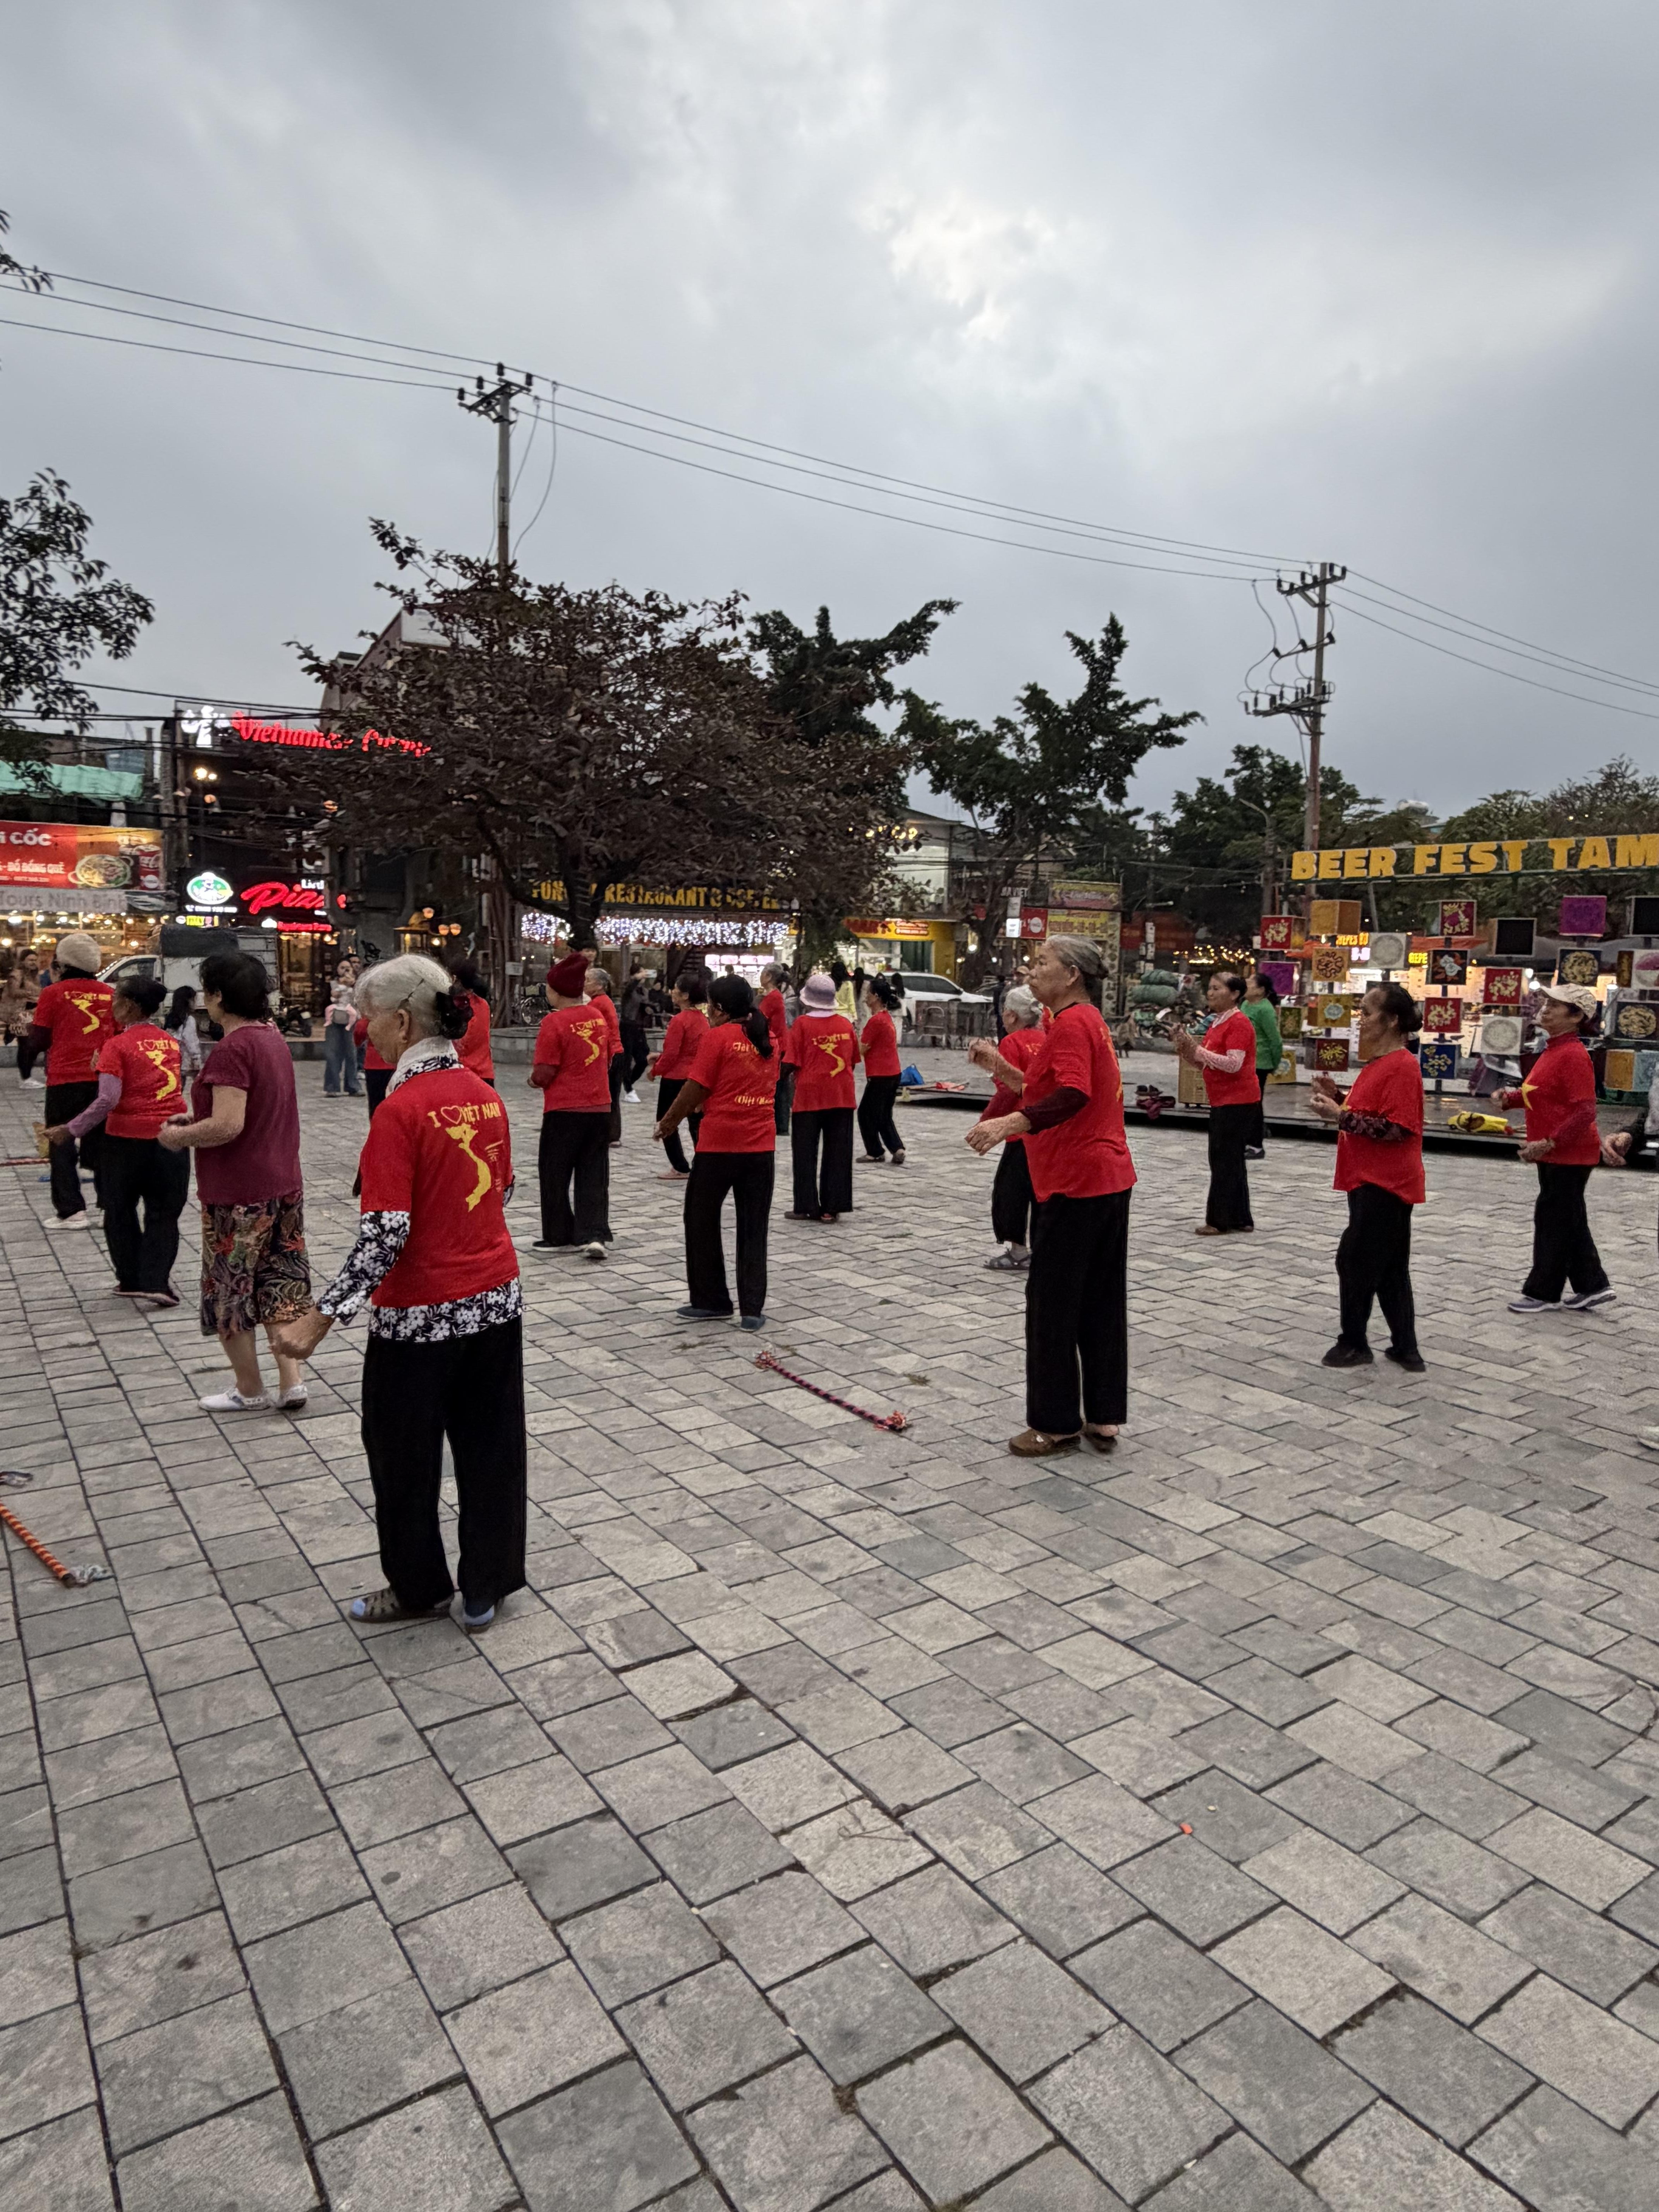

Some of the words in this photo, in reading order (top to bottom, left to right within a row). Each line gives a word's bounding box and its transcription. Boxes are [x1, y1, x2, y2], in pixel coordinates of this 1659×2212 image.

[10, 828, 52, 846] CỐC
[1291, 847, 1396, 880] BEER
[1413, 840, 1528, 875] FEST
[1547, 833, 1659, 870] TAM
[427, 1111, 441, 1128] I
